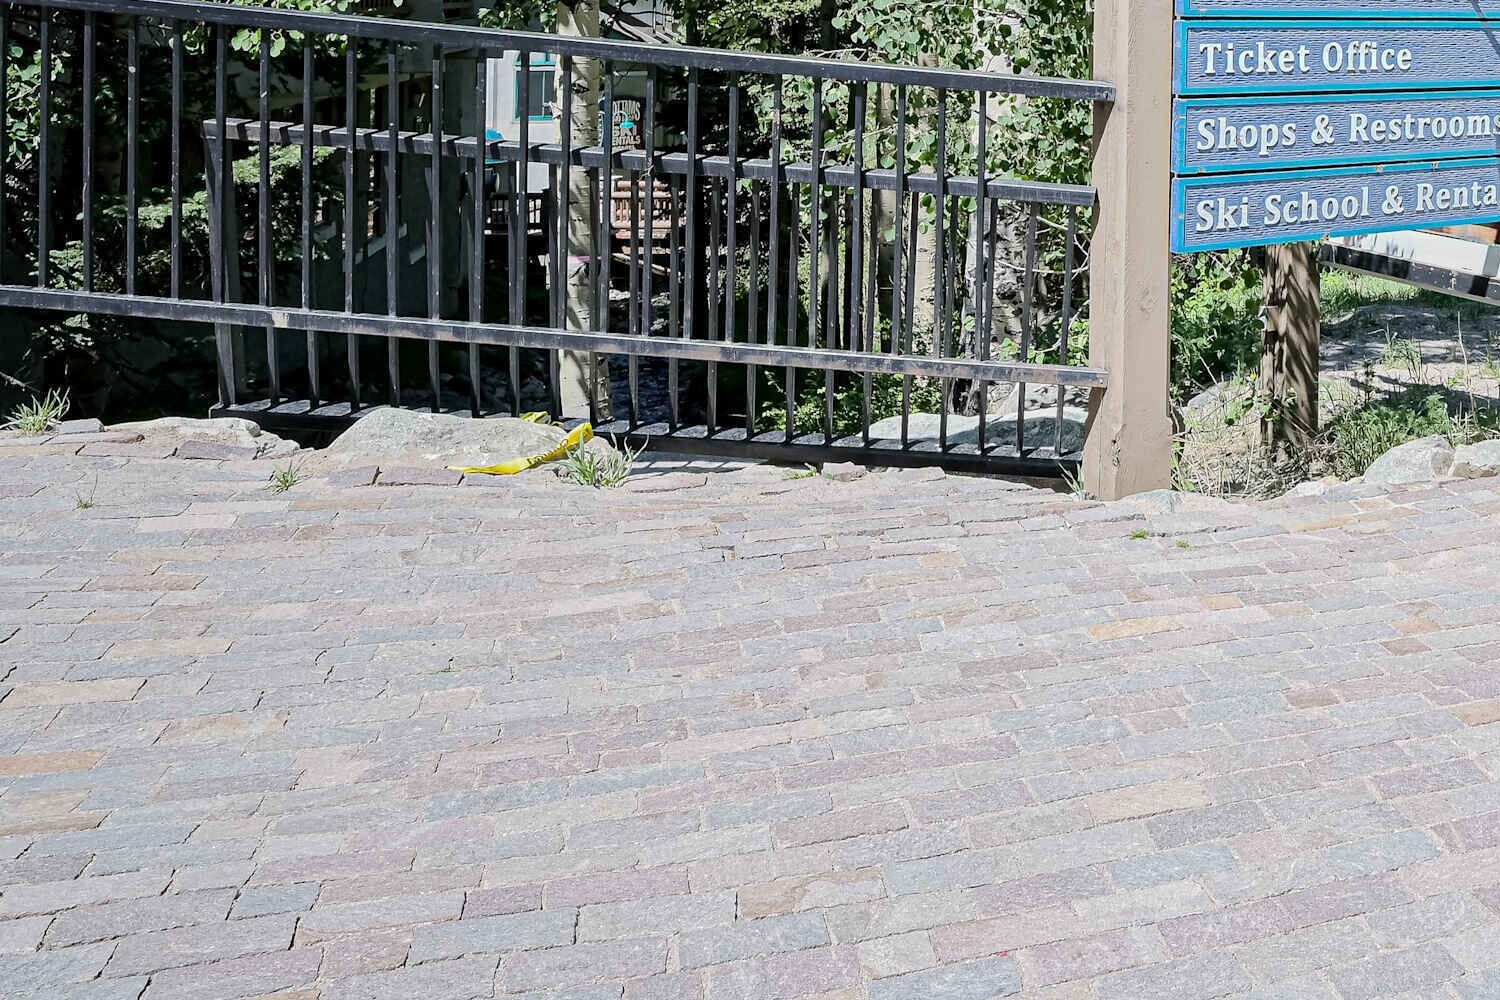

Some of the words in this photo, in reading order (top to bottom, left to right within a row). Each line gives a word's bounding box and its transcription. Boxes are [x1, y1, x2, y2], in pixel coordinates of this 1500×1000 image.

[1200, 42, 1309, 75] Ticket
[1322, 40, 1412, 72] Office
[1196, 117, 1296, 156] Shops
[1311, 113, 1335, 145] &
[1196, 197, 1249, 233] Ski
[1264, 183, 1369, 226] School
[1381, 183, 1404, 215] &
